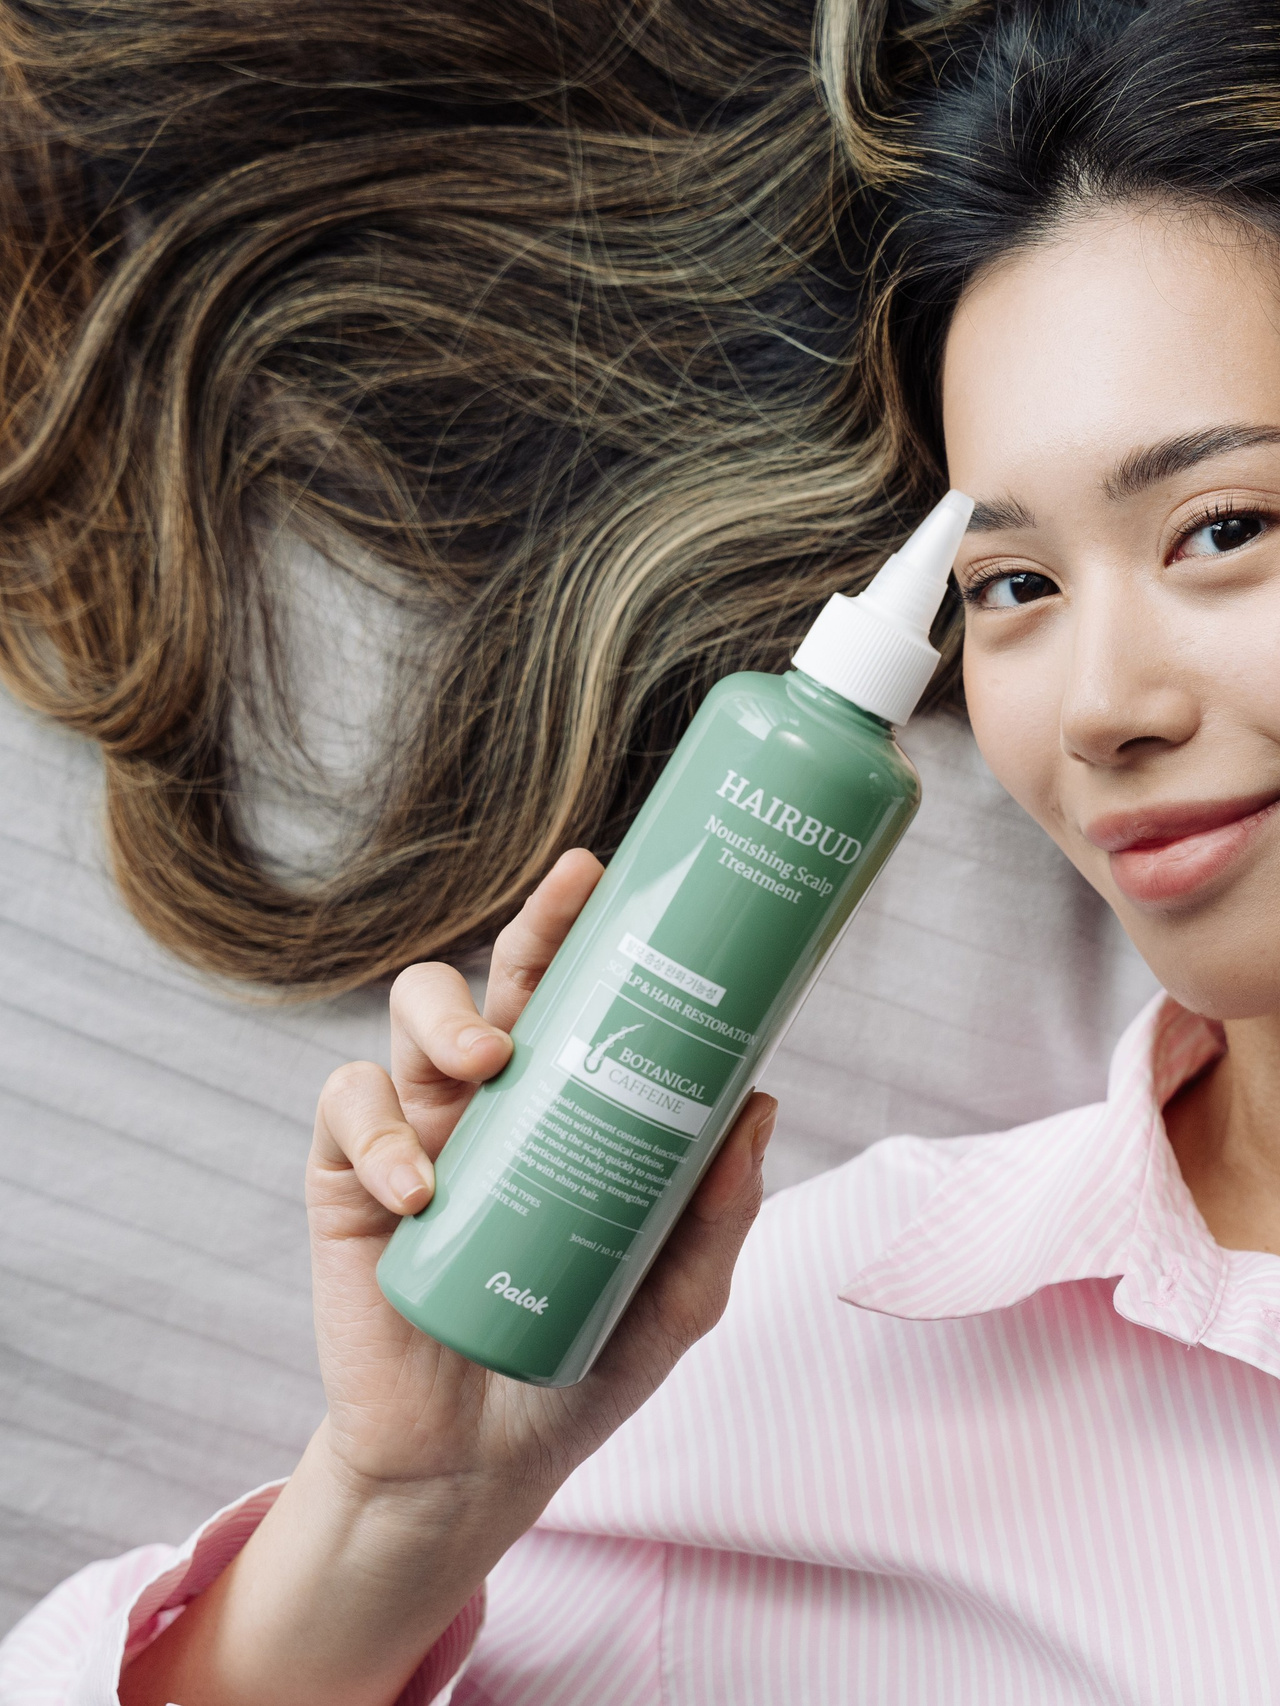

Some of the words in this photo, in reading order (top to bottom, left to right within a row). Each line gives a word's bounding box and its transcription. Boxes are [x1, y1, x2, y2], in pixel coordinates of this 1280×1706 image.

[715, 767, 863, 865] HAIRBUD
[702, 811, 793, 877] Nourishing
[792, 865, 833, 897] Scalp
[714, 844, 800, 902] Treatment
[604, 957, 644, 990] SCALP
[648, 985, 682, 1012] HAIR
[679, 1001, 759, 1045] RESTORATION
[606, 1066, 686, 1116] CAFFEINE
[616, 1044, 704, 1097] BOTANICAL
[572, 1104, 616, 1133] treatment
[614, 1128, 651, 1150] contains
[572, 1120, 593, 1136] with
[591, 1129, 633, 1156] botanical
[630, 1152, 664, 1171] caffeine,
[514, 1147, 538, 1170] scalp
[535, 1161, 555, 1178] with
[553, 1173, 580, 1192] shiny
[578, 1185, 598, 1201] hair.
[525, 1140, 569, 1171] particular
[565, 1164, 606, 1189] nutrients
[604, 1184, 649, 1207] strengthen
[527, 1123, 548, 1141] hair
[544, 1136, 567, 1153] roots
[566, 1149, 585, 1163] and
[583, 1156, 604, 1174] help
[602, 1168, 632, 1186] reduce
[630, 1179, 648, 1192] hair
[566, 1133, 583, 1146] the
[581, 1142, 605, 1159] scalp
[603, 1153, 636, 1174] quickly
[635, 1167, 645, 1177] to
[498, 1175, 519, 1195] HAIR
[517, 1188, 541, 1208] TYPES
[508, 1199, 529, 1216] FREE
[483, 1270, 548, 1314] Aalok
